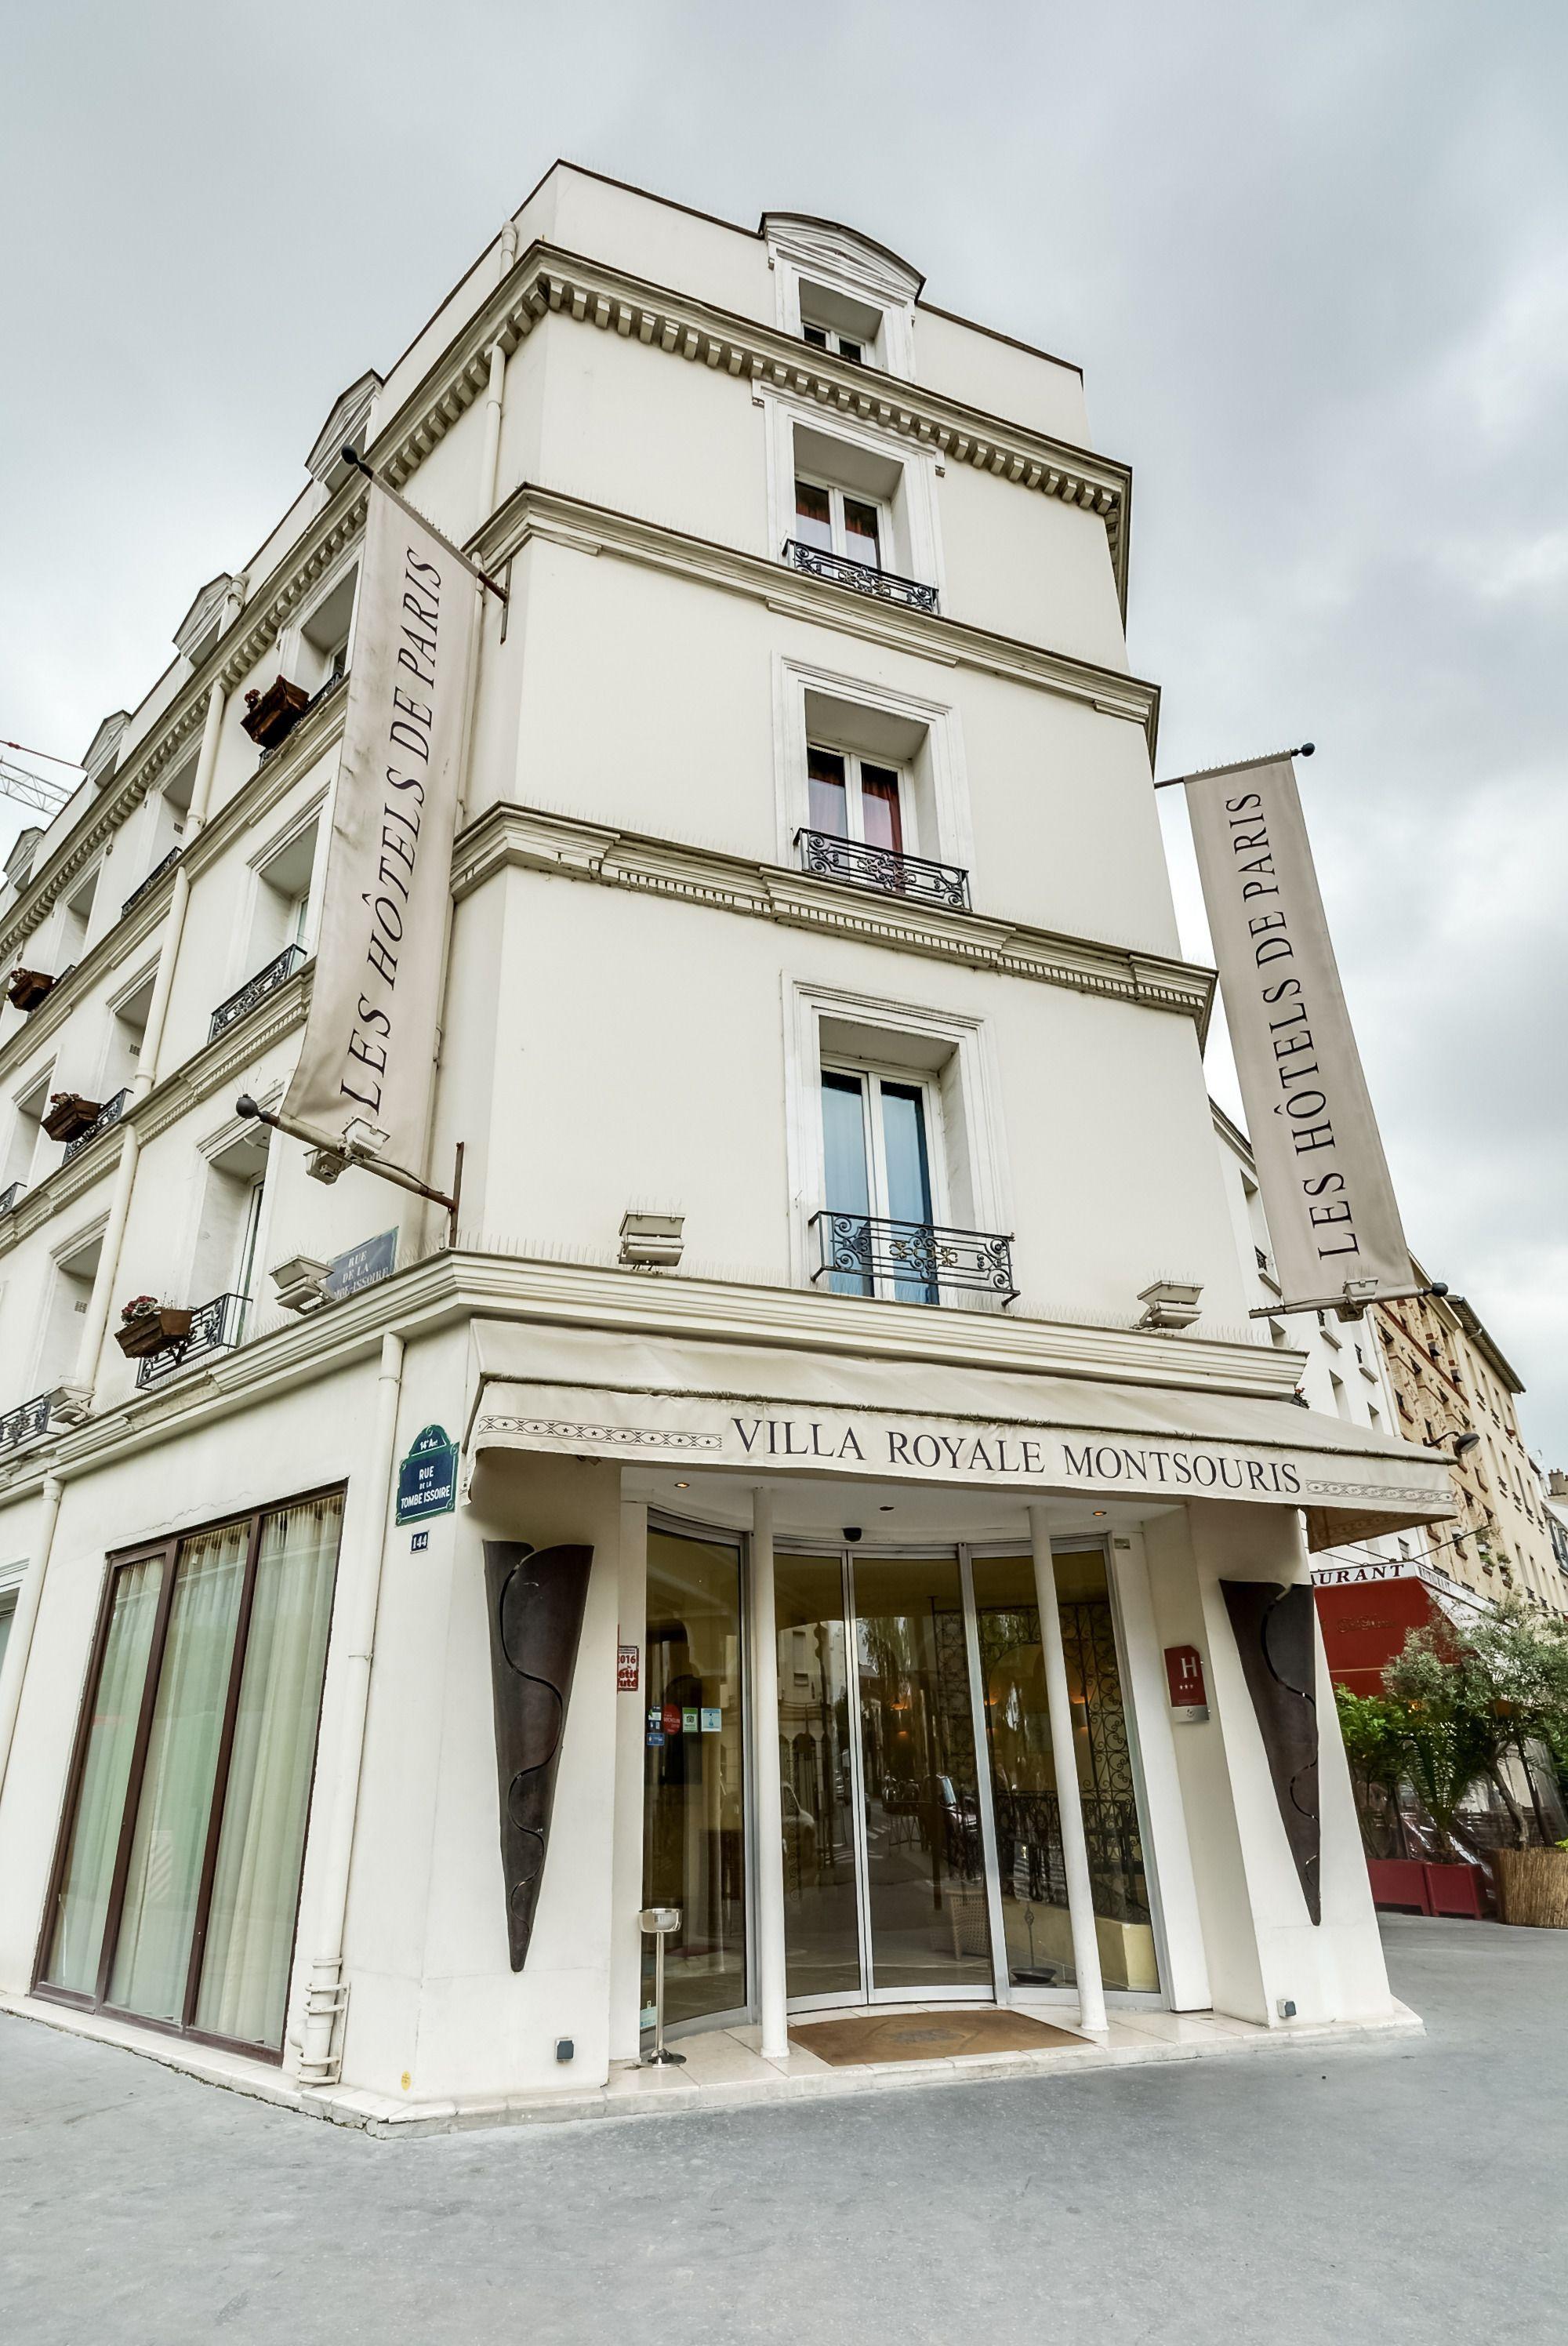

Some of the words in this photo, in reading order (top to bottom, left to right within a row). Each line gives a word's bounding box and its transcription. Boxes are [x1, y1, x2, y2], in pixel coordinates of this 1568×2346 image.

[397, 547, 441, 689] PARIS
[390, 686, 433, 764] DE
[361, 766, 425, 991] HÔTELS
[1226, 794, 1279, 902] PARIS
[1249, 912, 1294, 969] DE
[340, 992, 391, 1117] LES
[1262, 979, 1336, 1156] HÔTELS
[1303, 1172, 1360, 1261] LES
[343, 1269, 355, 1284] DE
[357, 1263, 369, 1276] LA
[348, 1251, 368, 1268] RUE
[419, 1466, 434, 1480] RUE
[731, 1418, 866, 1461] VILLA
[887, 1432, 1045, 1473] ROYALE
[1062, 1444, 1301, 1494] MONTSOURIS
[401, 1493, 423, 1509] TOMBE
[423, 1485, 451, 1503] ISSOIRE
[412, 1534, 428, 1549] 144
[618, 1654, 637, 1664] 016
[1181, 1656, 1199, 1678] H
